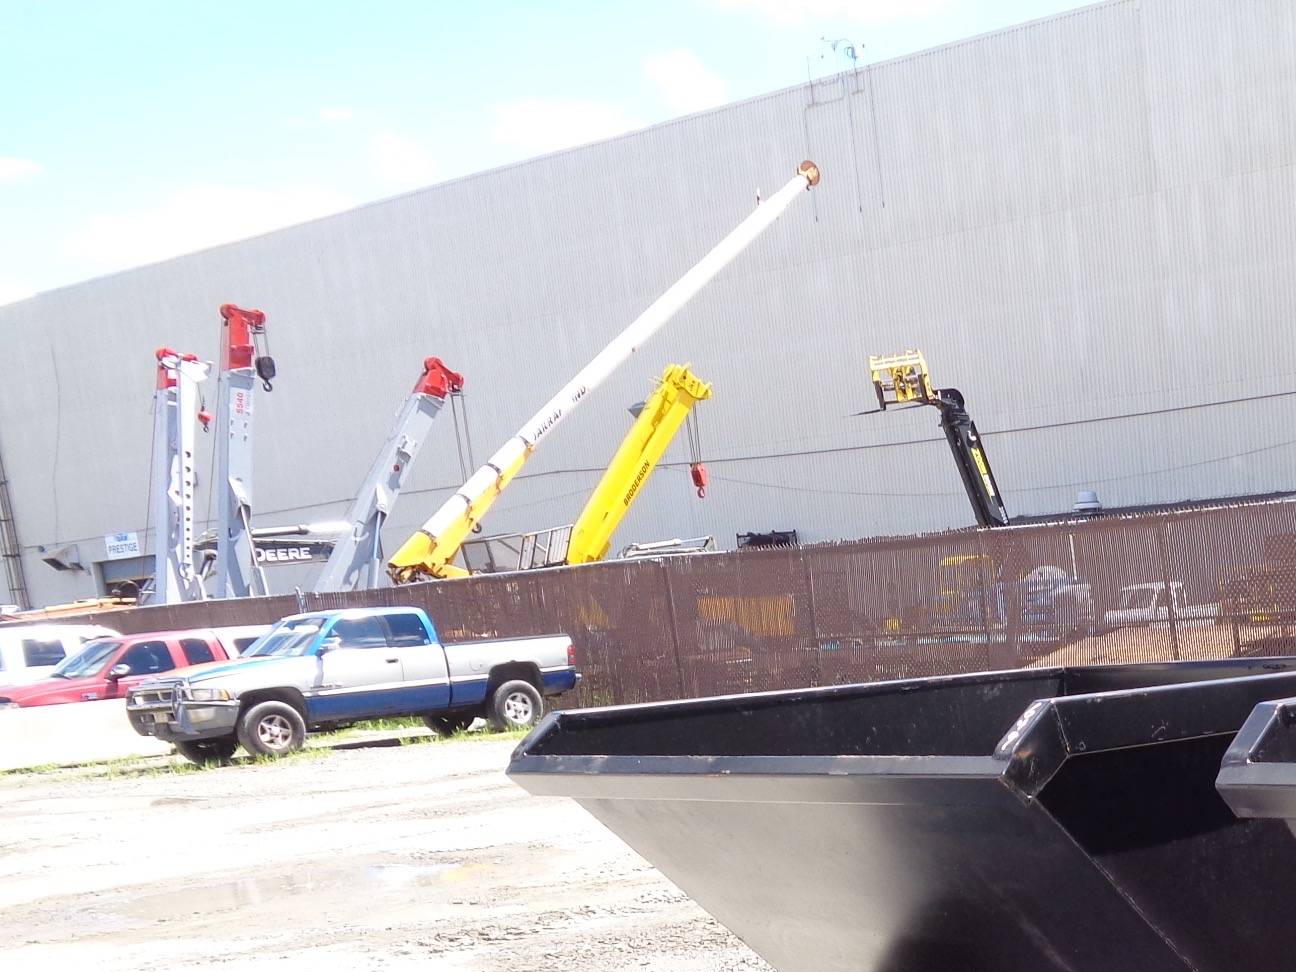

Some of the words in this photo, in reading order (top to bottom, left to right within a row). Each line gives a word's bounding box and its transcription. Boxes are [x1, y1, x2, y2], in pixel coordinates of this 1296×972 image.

[236, 392, 244, 414] 5540
[623, 459, 650, 507] BRODERSON
[108, 542, 138, 555] PRESTIGE
[255, 546, 312, 562] DEERE
